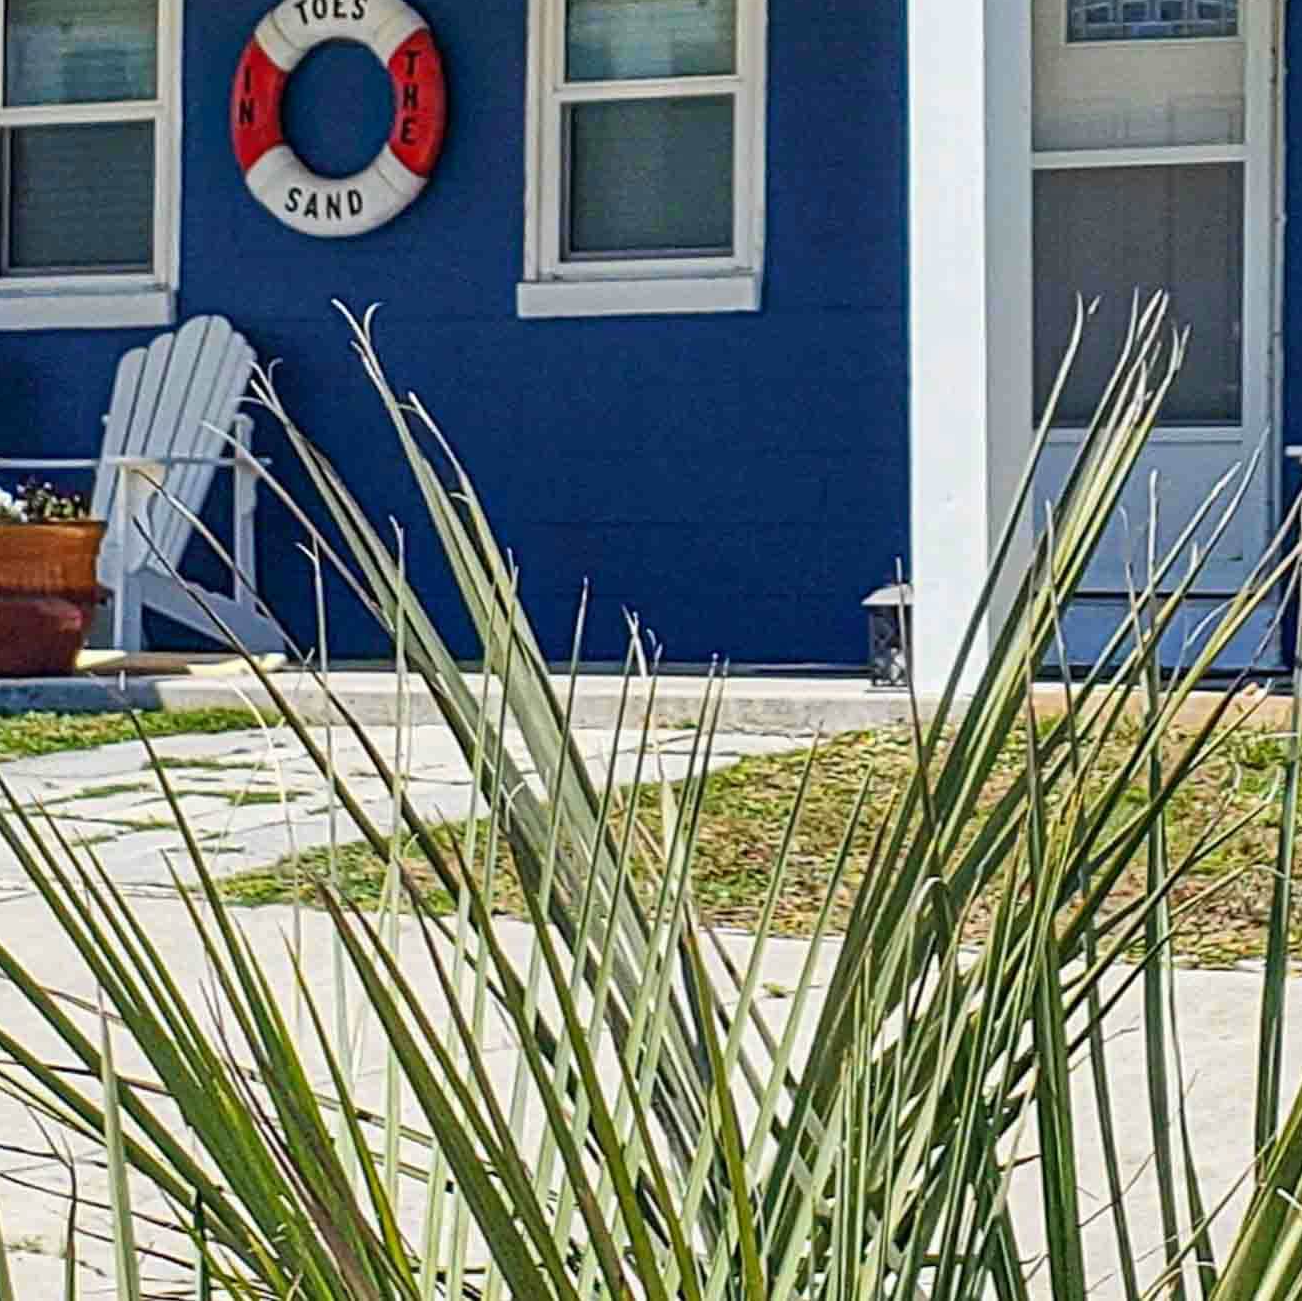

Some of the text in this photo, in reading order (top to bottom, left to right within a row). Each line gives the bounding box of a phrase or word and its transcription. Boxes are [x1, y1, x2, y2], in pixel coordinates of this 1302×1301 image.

[238, 65, 254, 123] IN
[402, 50, 421, 145] THE
[285, 187, 364, 220] SAND
